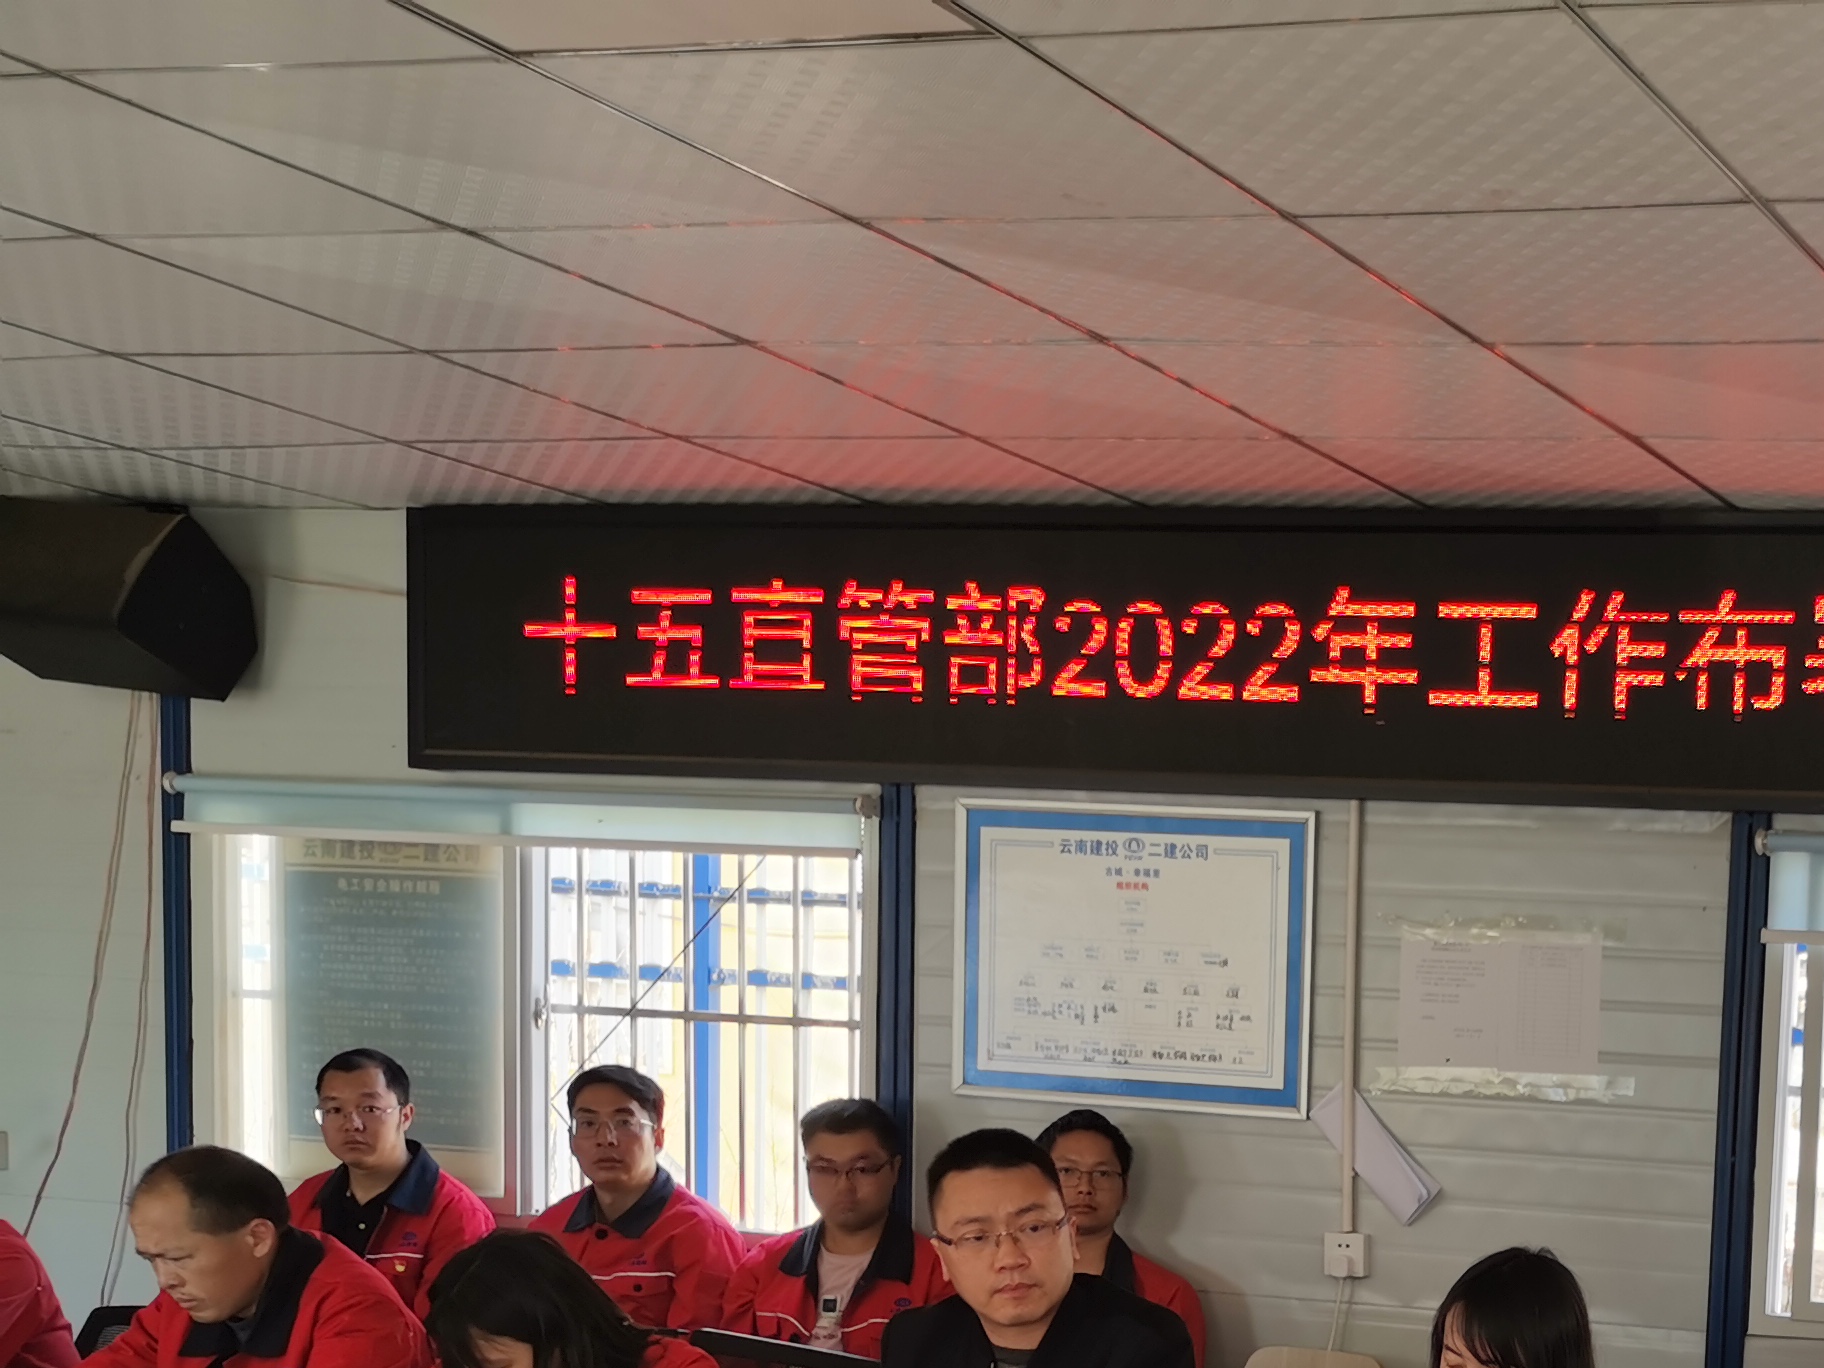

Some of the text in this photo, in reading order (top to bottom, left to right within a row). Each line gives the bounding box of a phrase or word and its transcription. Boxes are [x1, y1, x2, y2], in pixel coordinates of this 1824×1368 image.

[1058, 837, 1210, 862] 云南建投 二建公司
